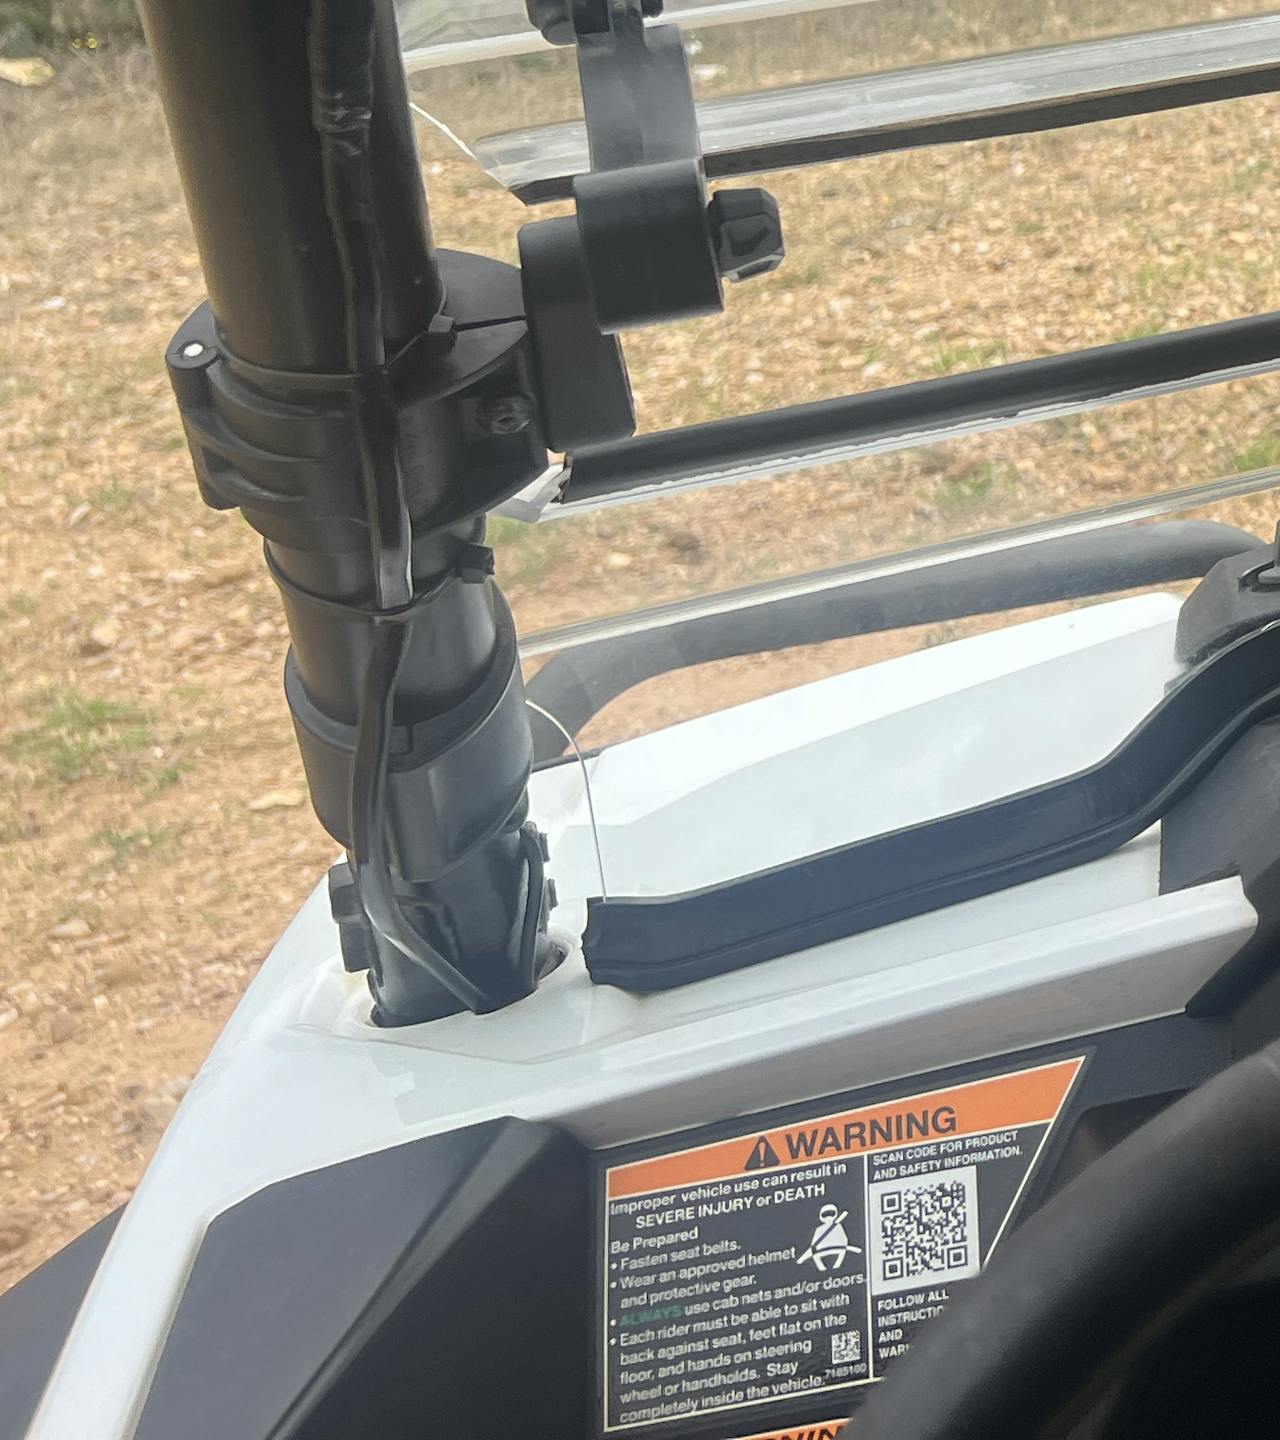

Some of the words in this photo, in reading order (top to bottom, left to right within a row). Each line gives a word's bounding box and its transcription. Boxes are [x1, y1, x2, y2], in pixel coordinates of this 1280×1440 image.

[785, 1106, 957, 1159] WARNING
[873, 1151, 904, 1166] SCAN
[906, 1145, 937, 1160] CODE
[940, 1142, 963, 1155] FOR
[965, 1130, 1018, 1149] PRODUCT
[873, 1167, 897, 1181] AND
[900, 1159, 943, 1176] SAFETY
[944, 1145, 1023, 1168] INFORMATION.
[610, 1194, 677, 1215] Improper
[681, 1182, 732, 1202] vehicle
[734, 1179, 760, 1193] use
[762, 1175, 788, 1187] can
[791, 1164, 831, 1183] result
[833, 1162, 847, 1175] in
[635, 1206, 696, 1229] SEVERE
[698, 1195, 754, 1218] INJURY
[756, 1195, 772, 1207] or
[774, 1182, 825, 1204] DEATH
[611, 1240, 630, 1254] Be
[633, 1226, 699, 1250] Prepared
[620, 1253, 668, 1271] Fasten
[670, 1245, 700, 1262] seat
[703, 1239, 742, 1256] belts.
[620, 1273, 657, 1289] Wear
[659, 1270, 677, 1283] an
[680, 1255, 746, 1280] approved
[749, 1247, 796, 1266] helmet
[620, 1292, 648, 1308] and
[649, 1281, 720, 1306] protective
[723, 1274, 757, 1293] gear.
[620, 1305, 682, 1327] ALWAYS
[684, 1302, 710, 1316] use
[712, 1295, 739, 1311] cab
[741, 1289, 772, 1305] nets
[774, 1280, 821, 1298] and/or
[877, 1293, 925, 1312] FOLLOW
[928, 1289, 949, 1303] ALL
[620, 1329, 655, 1347] Each
[657, 1323, 691, 1339] rider
[692, 1315, 728, 1333] must
[730, 1313, 749, 1326] be
[751, 1306, 781, 1322] able
[784, 1304, 798, 1316] to
[801, 1298, 817, 1313] sit
[820, 1293, 850, 1309] with
[620, 1348, 654, 1366] back
[657, 1338, 709, 1360] against
[712, 1332, 746, 1349] seat,
[749, 1325, 777, 1341] feet
[779, 1321, 801, 1336] flat
[803, 1319, 821, 1331] on
[824, 1314, 847, 1328] the
[878, 1329, 903, 1343] AND
[620, 1369, 654, 1385] floor,
[658, 1361, 684, 1378] and
[688, 1353, 731, 1372] hands
[734, 1351, 752, 1363] on
[755, 1339, 812, 1360] steering
[620, 1384, 662, 1404] wheel
[664, 1383, 680, 1396] or
[682, 1368, 760, 1392] handholds.
[766, 1361, 799, 1377] Stay
[620, 1398, 699, 1423] completely
[702, 1389, 744, 1407] inside
[747, 1385, 769, 1400] the
[772, 1375, 826, 1395] vehicle.
